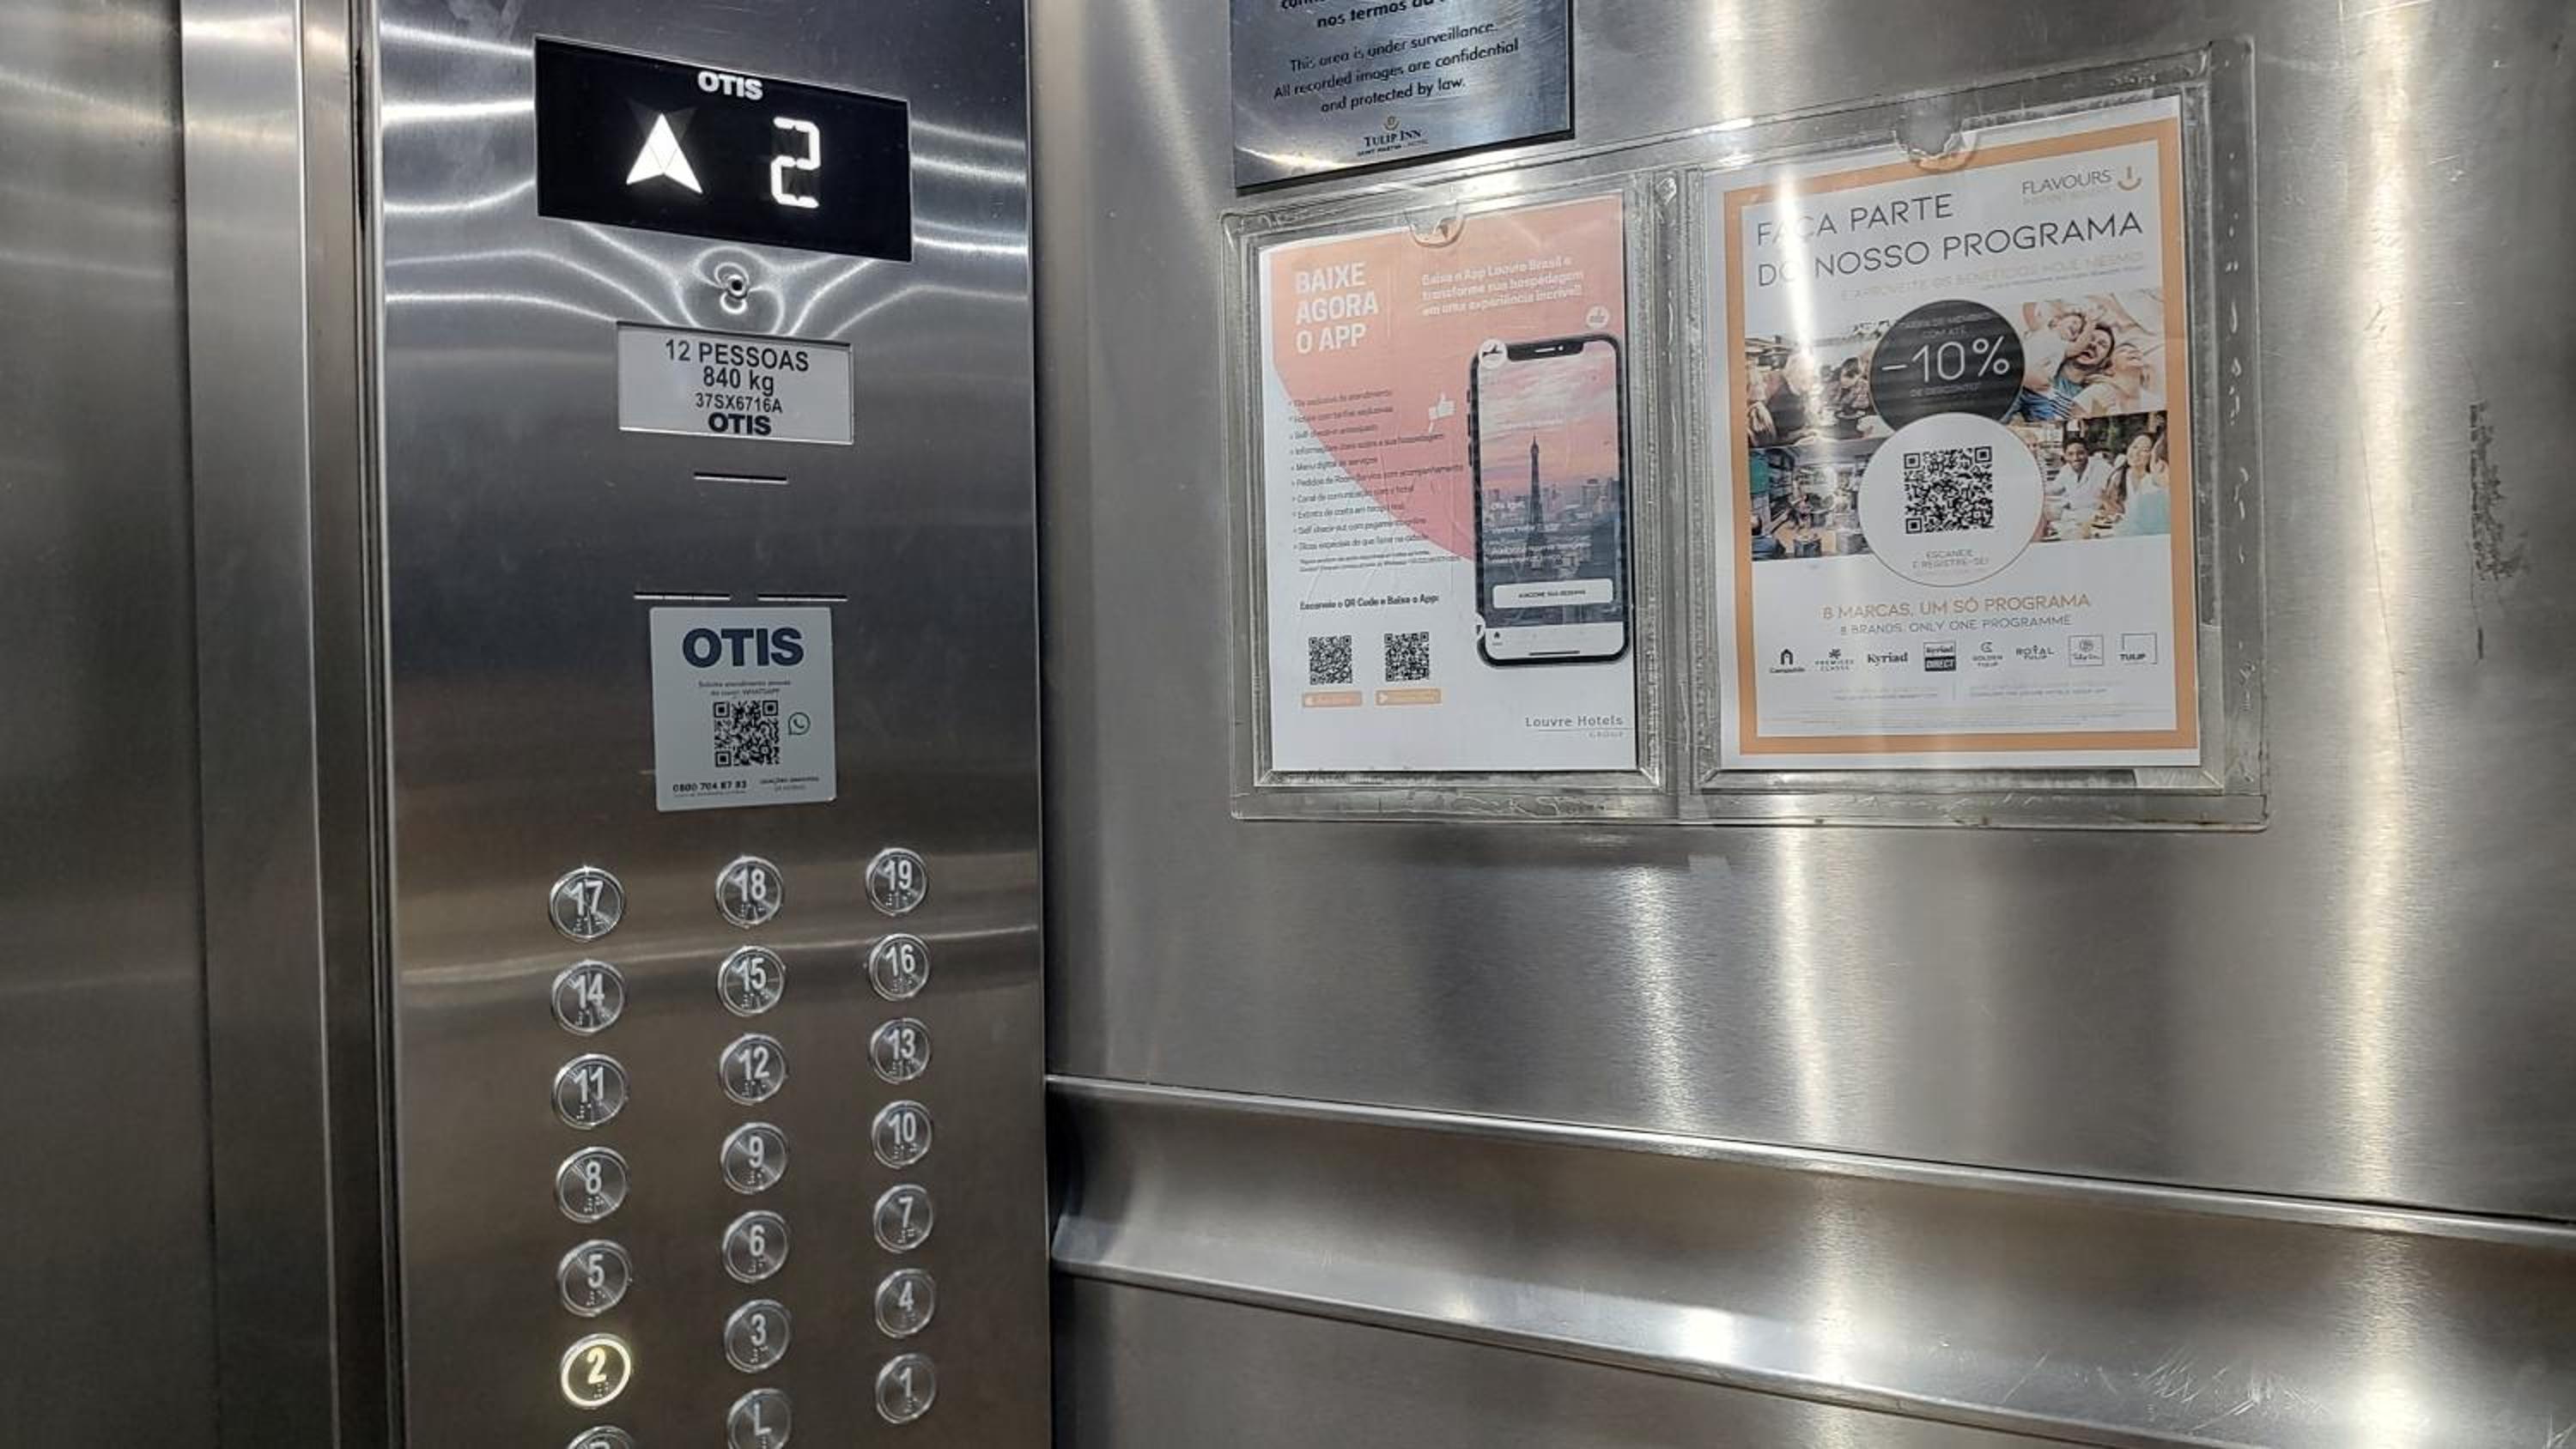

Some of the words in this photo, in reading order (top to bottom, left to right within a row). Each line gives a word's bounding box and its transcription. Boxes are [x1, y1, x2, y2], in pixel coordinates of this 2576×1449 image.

[1317, 15, 1346, 28] nos
[1351, 1, 1407, 22] termos
[1273, 84, 1291, 100] All
[1294, 72, 1352, 95] recorded
[1356, 66, 1404, 87] images
[1408, 60, 1431, 73] are
[1435, 38, 1519, 69] confidential
[1291, 57, 1315, 72] This
[1320, 53, 1349, 67] area
[1353, 51, 1365, 62] is
[1368, 39, 1408, 57] under
[698, 70, 763, 100] OTIS
[1321, 95, 1347, 113] and
[1351, 85, 1413, 111] protected
[1418, 79, 1433, 98] by
[1363, 133, 1397, 147] TULIP
[770, 116, 822, 209] 2
[2021, 169, 2112, 194] FLAVOURS
[1850, 193, 1953, 232] PARTE
[1814, 241, 1930, 278] NOSSO
[1942, 211, 2144, 260] PROGRAMA
[1296, 262, 1366, 294] BAIXE
[1296, 292, 1379, 324] AGORA
[665, 339, 691, 361] 12
[698, 342, 810, 372] PESSOAS
[1296, 329, 1312, 355] O
[1319, 323, 1367, 352] APP
[703, 366, 742, 389] 840
[749, 369, 775, 397] kg
[696, 392, 784, 414] 37SX6716A
[708, 413, 773, 437] OTIS
[1344, 598, 1356, 608] QR
[1357, 597, 1379, 607] Code
[1920, 599, 1948, 615] UM
[1953, 596, 1980, 614] SÓ
[1984, 593, 2092, 611] PROGRAMA
[1909, 620, 1944, 633] ONLY
[1949, 620, 1978, 631] ONE
[1983, 614, 2074, 629] PROGRAMME
[682, 627, 805, 669] OTIS
[1867, 652, 1908, 667] Kyriad
[1525, 717, 1572, 728] Louvre
[1577, 714, 1624, 726] Hotels
[701, 781, 718, 790] 704
[734, 868, 767, 902] 18
[884, 858, 912, 891] 19
[571, 880, 604, 915] 17
[737, 957, 767, 991] 15
[885, 943, 916, 976] 16
[572, 973, 605, 1009] 14
[887, 1028, 916, 1060] 13
[738, 1046, 770, 1081] 12
[573, 1067, 605, 1103] 11
[888, 1111, 918, 1143] 10
[748, 1135, 764, 1169] 9
[585, 1160, 602, 1195] 8
[897, 1196, 914, 1229] 7
[748, 1224, 765, 1257] 6
[586, 1253, 605, 1288] 5
[898, 1281, 914, 1313] 4
[750, 1313, 766, 1347] 3
[586, 1346, 607, 1385] 2
[899, 1367, 913, 1398] 1
